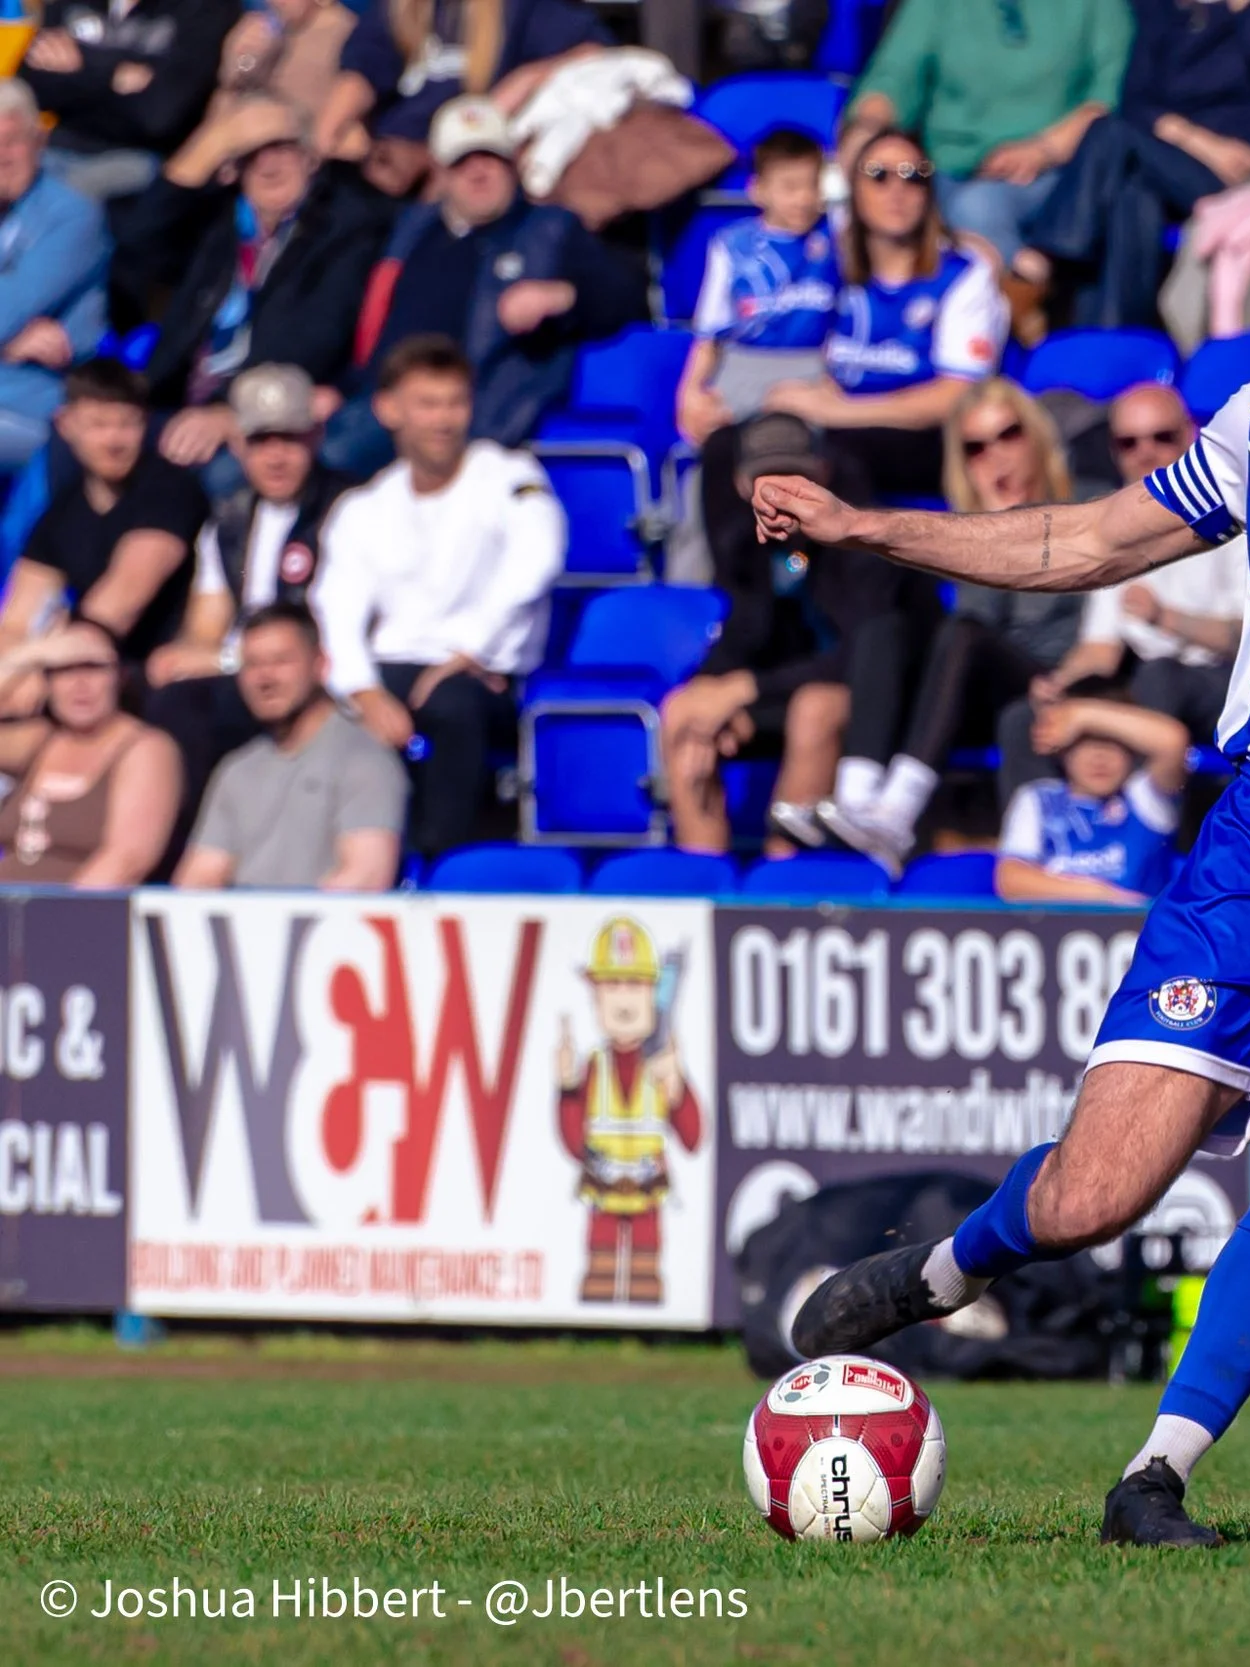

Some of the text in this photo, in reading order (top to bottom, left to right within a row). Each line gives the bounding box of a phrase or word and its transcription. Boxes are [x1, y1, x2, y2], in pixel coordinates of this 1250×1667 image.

[54, 983, 106, 1081] &
[729, 925, 891, 1059] 0161
[902, 928, 1047, 1062] 303
[728, 1067, 1083, 1156] www.wandwlt
[0, 1117, 124, 1217] CIAL
